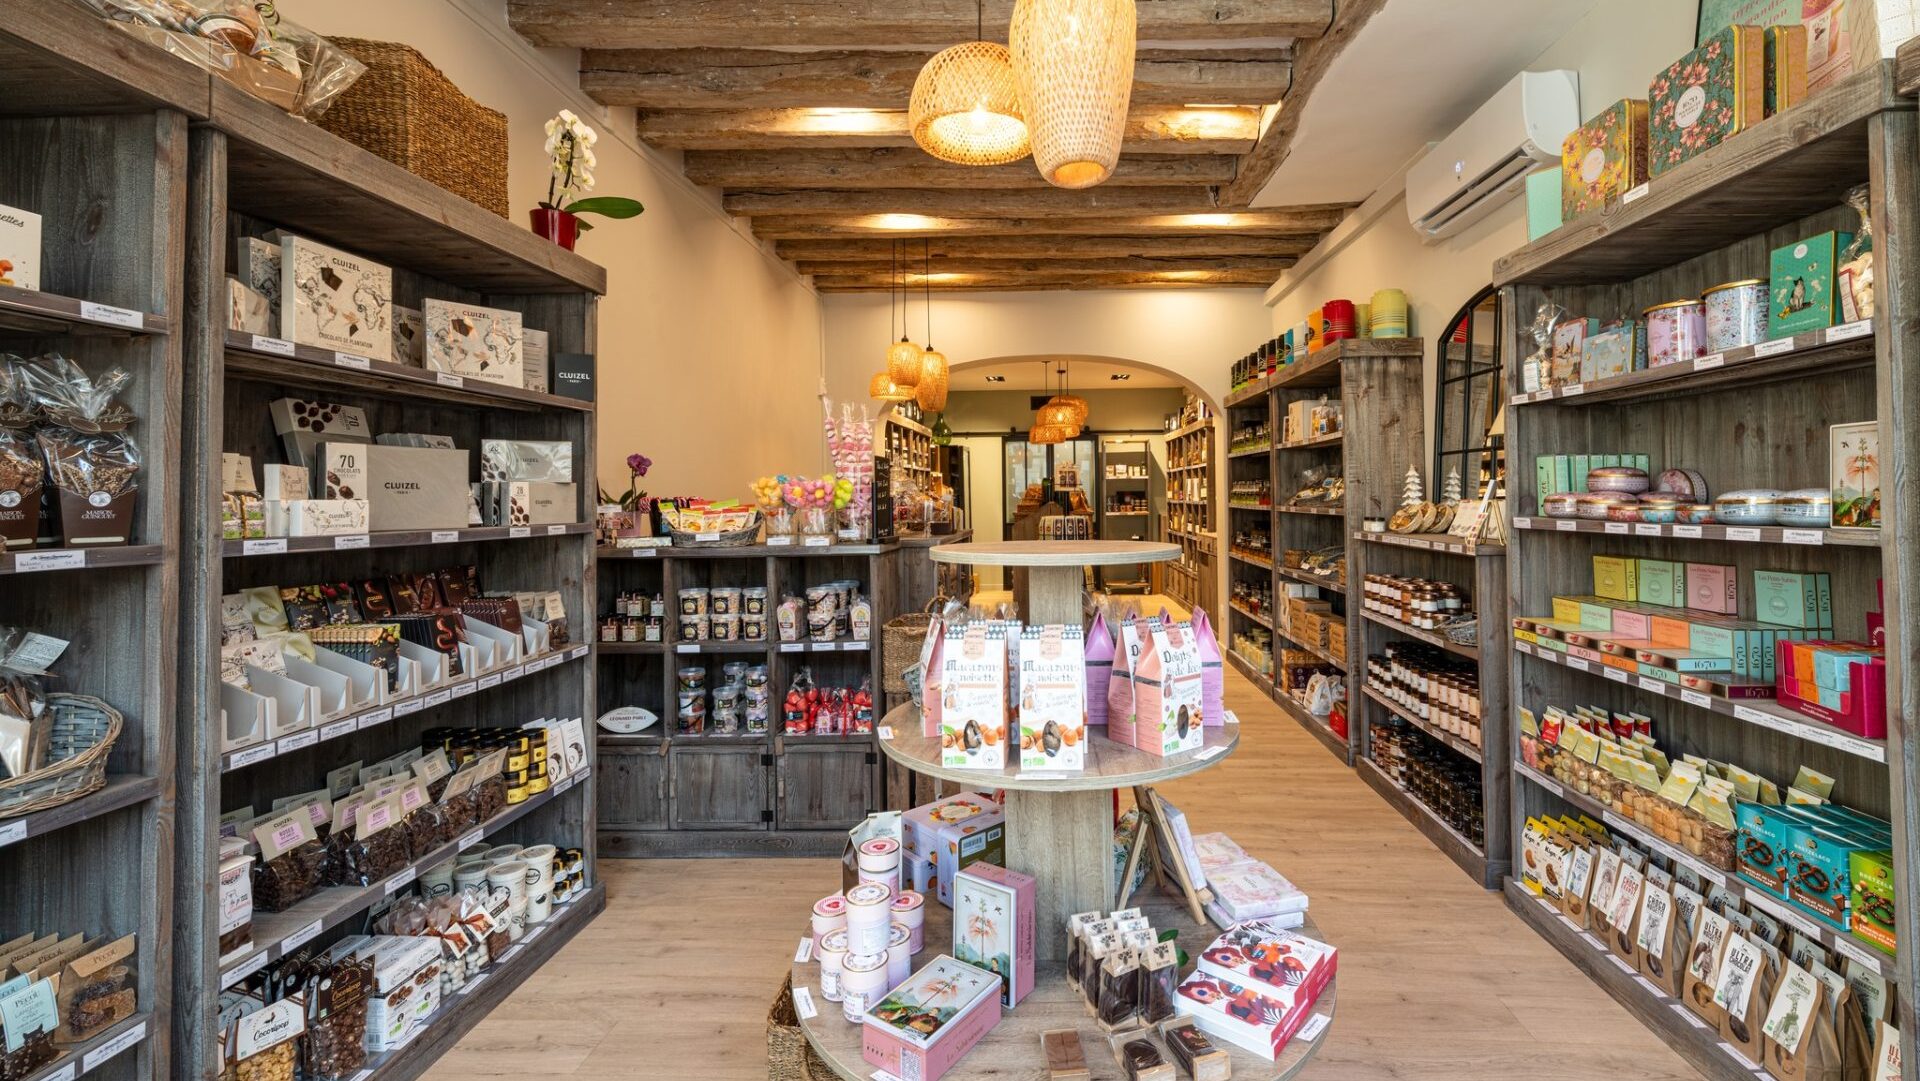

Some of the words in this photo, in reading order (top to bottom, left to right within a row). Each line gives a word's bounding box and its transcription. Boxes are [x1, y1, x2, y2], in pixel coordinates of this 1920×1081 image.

[332, 257, 361, 272] CLUIZEL
[462, 310, 491, 320] CLUIZEL
[319, 331, 342, 343] CHOCOLATS
[350, 340, 373, 349] PLANTATION
[558, 372, 591, 380] CLUIZEL
[347, 415, 360, 428] 70
[340, 455, 355, 469] 70
[384, 482, 421, 490] CLUIZEL
[517, 486, 524, 495] 28
[1806, 590, 1815, 612] 1670
[1821, 590, 1829, 612] 1670
[1163, 650, 1192, 664] Doigts
[1577, 649, 1591, 658] 1670
[1736, 647, 1745, 669] 1670
[1752, 647, 1760, 669] 1670
[1765, 646, 1773, 669] 1670
[945, 659, 1003, 672] Macarons
[1022, 660, 1080, 672] Macarons
[1694, 662, 1716, 670] 1670
[959, 673, 996, 682] noisette
[1038, 673, 1075, 682] noisette
[1650, 668, 1667, 679] 1670
[1745, 690, 1768, 698] 1670
[273, 817, 293, 828] CLUIZEL
[279, 827, 294, 837] ROSES
[1648, 895, 1666, 911] CHOCO
[1704, 921, 1723, 939] ULTRA
[1730, 948, 1754, 967] ULTRA
[253, 1019, 290, 1042] Cocoripop
